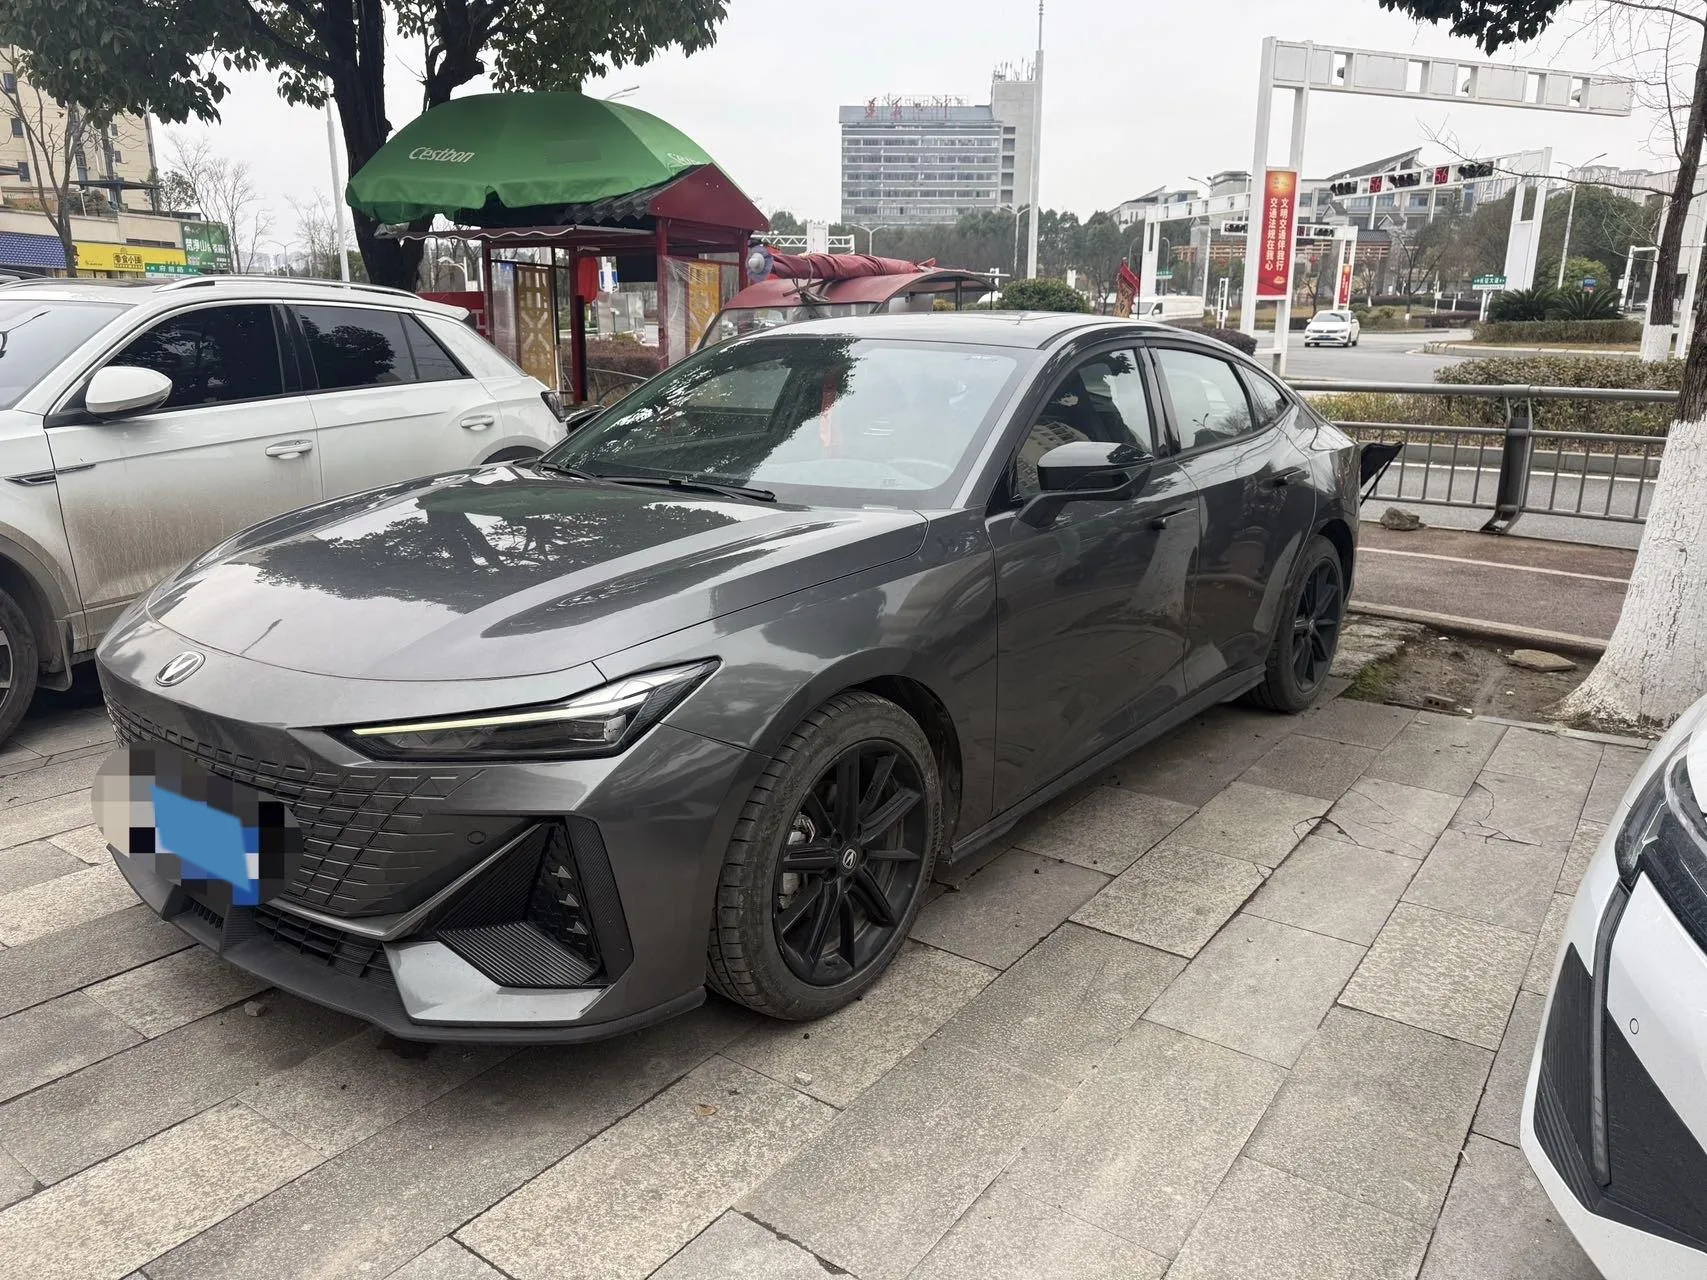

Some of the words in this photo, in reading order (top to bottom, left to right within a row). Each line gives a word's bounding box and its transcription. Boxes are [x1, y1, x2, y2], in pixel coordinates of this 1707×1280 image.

[1264, 196, 1278, 272] 交通法规在我心
[1275, 197, 1290, 272] 文明交通伴我行
